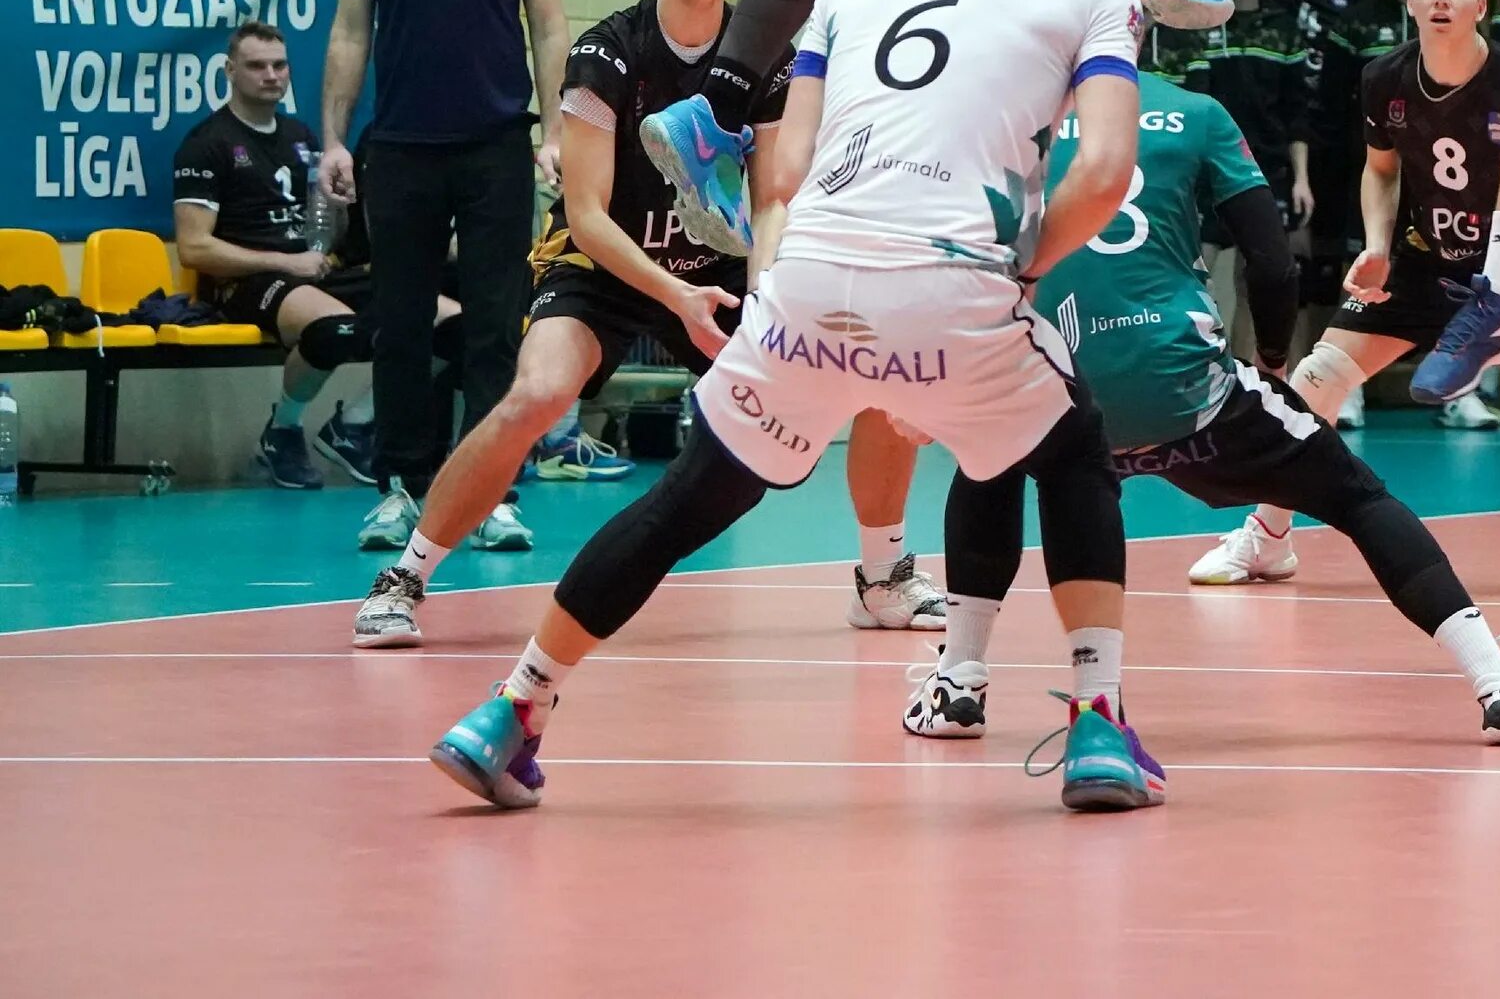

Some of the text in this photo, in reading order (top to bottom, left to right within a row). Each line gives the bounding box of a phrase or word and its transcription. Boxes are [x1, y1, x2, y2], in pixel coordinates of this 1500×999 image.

[35, 50, 297, 131] VOLEJBO
[35, 121, 148, 197] LĪGA
[872, 153, 952, 182] Jūrmala
[1432, 137, 1469, 191] 8
[1090, 308, 1162, 335] Jūrmala
[760, 320, 947, 387] MANGAĻI
